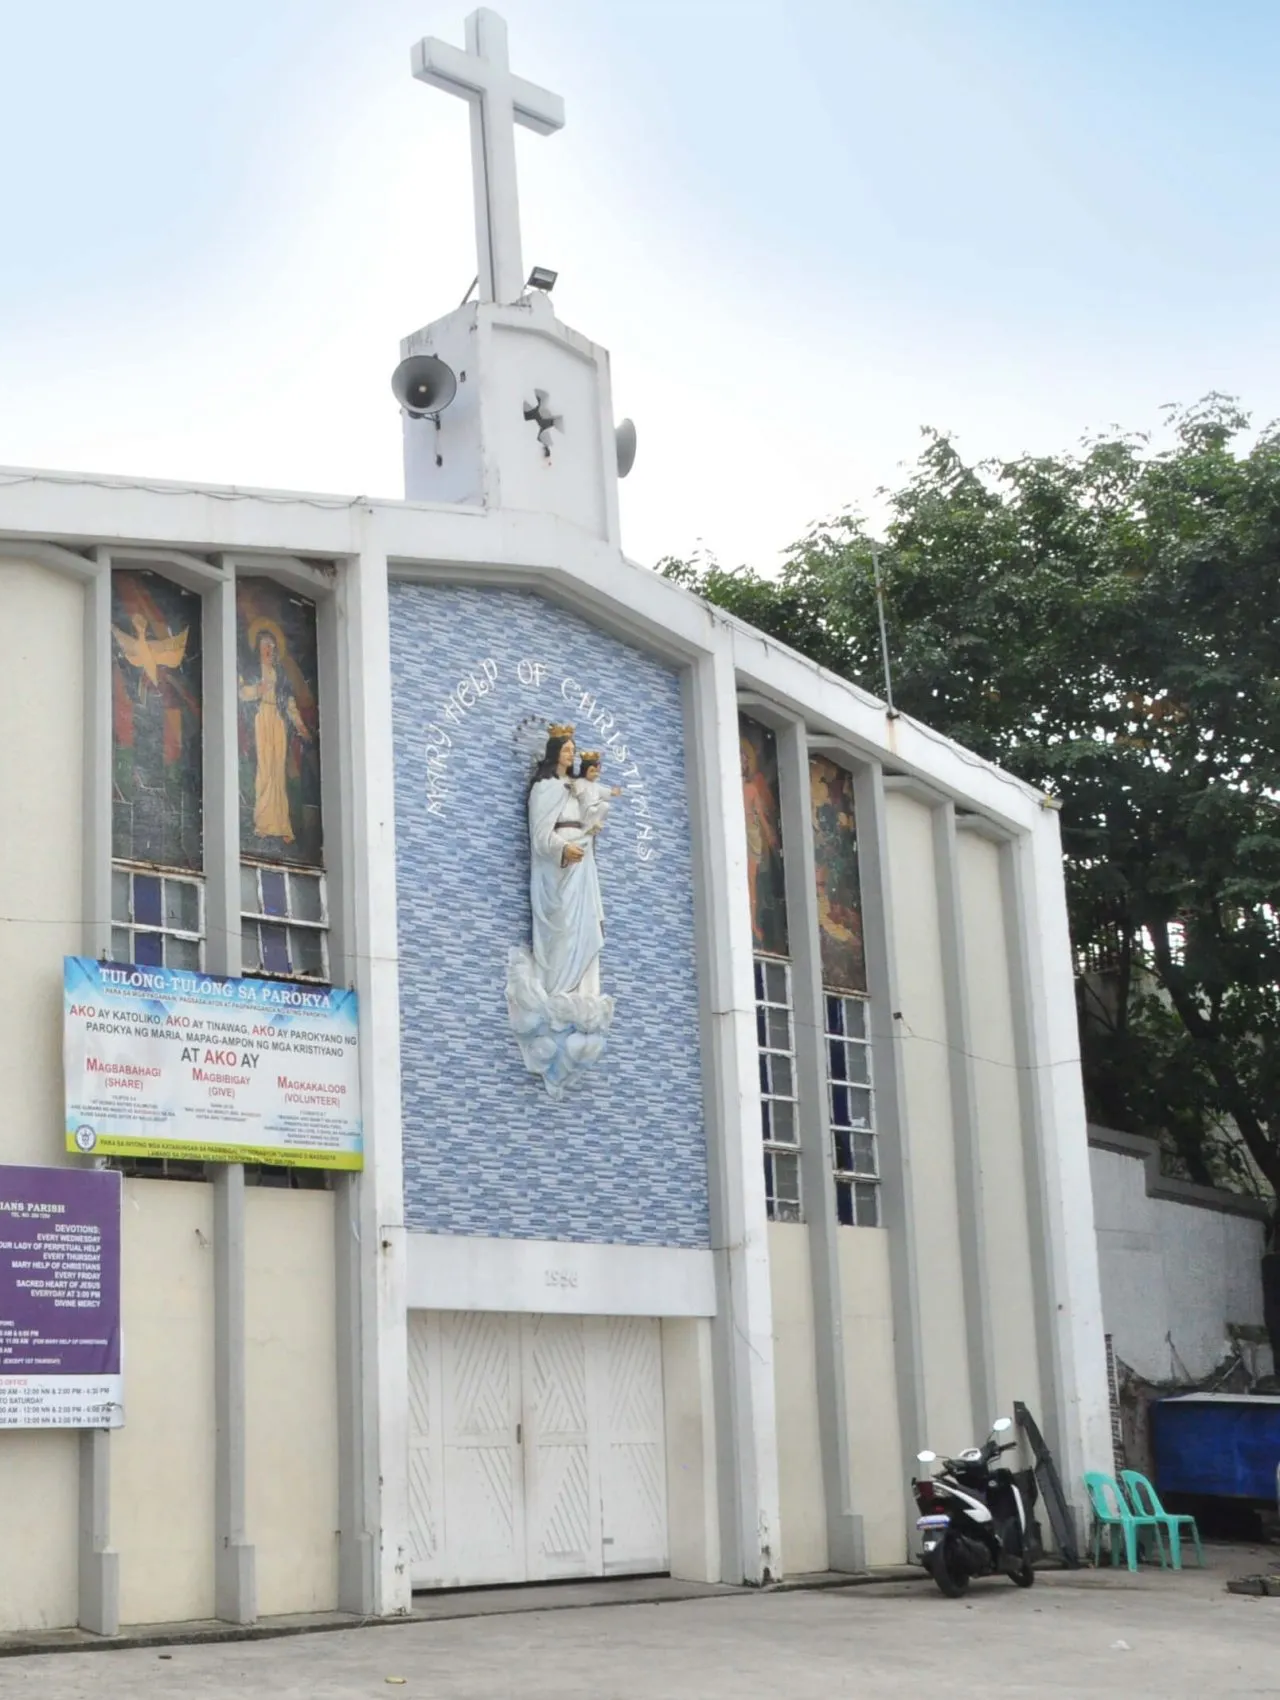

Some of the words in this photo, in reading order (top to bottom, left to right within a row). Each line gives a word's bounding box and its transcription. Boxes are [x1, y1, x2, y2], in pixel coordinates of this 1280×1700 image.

[426, 725, 452, 818] MARY
[443, 658, 498, 724] HELP
[517, 658, 549, 687] OF
[560, 678, 653, 862] CHRISTIANS
[99, 967, 233, 998] TULONG-TULONG
[238, 985, 258, 1001] SA
[261, 987, 333, 1009] PAROKYA
[70, 1005, 96, 1018] AKO
[98, 1010, 109, 1018] AY
[112, 1010, 163, 1026] KATOLIKO,
[166, 1015, 190, 1028] AKO
[192, 1020, 203, 1028] AY
[207, 1021, 250, 1035] TINAWAG,
[252, 1024, 276, 1037] AKO
[278, 1030, 290, 1038] AY
[291, 1031, 342, 1045] PAROKYANO
[344, 1037, 357, 1046] NG
[86, 1021, 132, 1035] PAROKYA
[135, 1028, 149, 1038] NG
[151, 1030, 183, 1042] MARIA,
[186, 1032, 254, 1050] MAPAG-AMPON
[256, 1040, 269, 1050] NG
[272, 1042, 291, 1052] MGA
[294, 1044, 344, 1058] KRISTIYANO
[181, 1047, 200, 1063] AT
[204, 1049, 237, 1067] AKO
[240, 1053, 260, 1069] AY
[104, 1078, 144, 1091] (SHARE)
[208, 1086, 236, 1099] (GIVE)
[284, 1093, 341, 1108] (VOLUNTEER)
[27, 1202, 65, 1214] PARISH
[54, 1224, 100, 1234] DEVOTIONS:
[36, 1233, 60, 1242] EVERY
[60, 1234, 100, 1243] WEDNESDAY
[14, 1242, 32, 1250] LADY
[33, 1242, 42, 1250] OF
[43, 1243, 82, 1252] PERPETUAL
[84, 1244, 101, 1252] HELP
[43, 1252, 66, 1260] EVERY
[67, 1253, 100, 1262] THURSDAY
[12, 1261, 32, 1269] MARY
[32, 1262, 50, 1270] HELP
[51, 1262, 60, 1270] OF
[61, 1262, 101, 1271] CHRISTIANS
[54, 1272, 76, 1280] EVERY
[77, 1272, 100, 1280] FRIDAY
[16, 1280, 44, 1288] SACRED
[46, 1280, 68, 1289] HEART
[69, 1281, 78, 1289] OF
[79, 1282, 100, 1290] JESUS
[30, 1290, 66, 1298] EVERYDAY
[78, 1300, 100, 1308] MERCY
[8, 1406, 18, 1414] AM
[101, 1416, 111, 1424] PM
